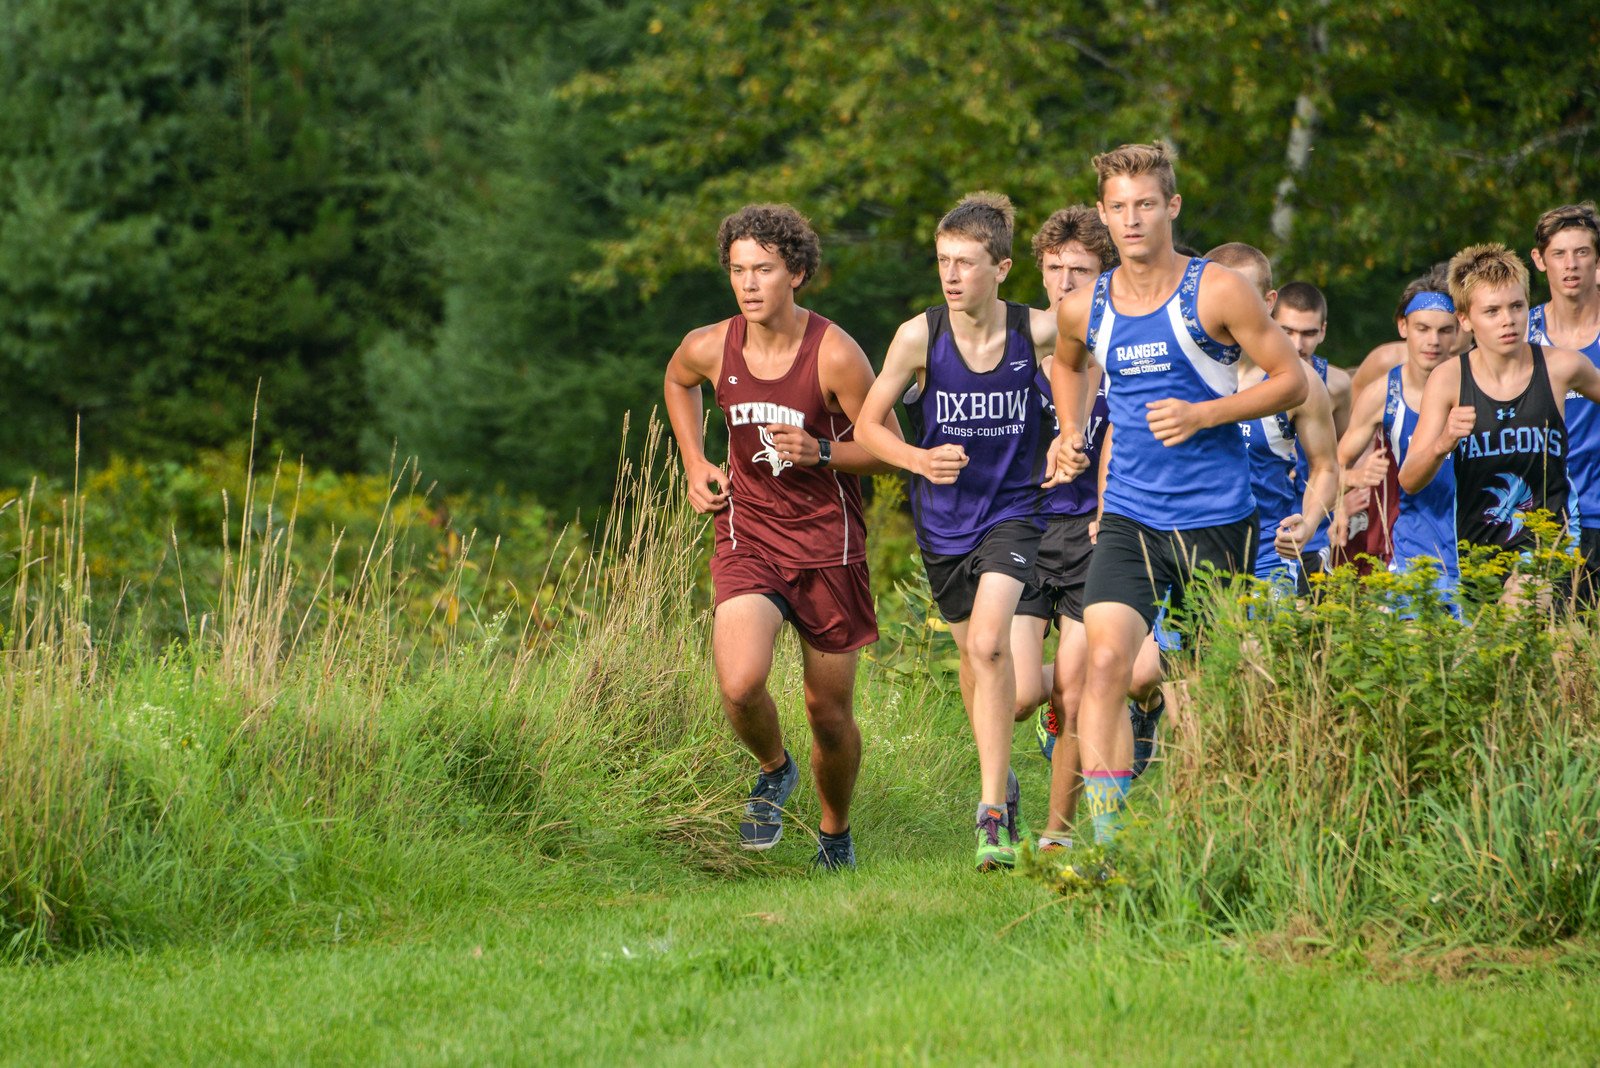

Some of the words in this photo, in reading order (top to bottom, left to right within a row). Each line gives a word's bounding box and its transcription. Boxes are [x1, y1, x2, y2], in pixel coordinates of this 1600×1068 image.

[1116, 341, 1169, 361] RANGER
[1119, 366, 1142, 376] CROSS
[1141, 362, 1171, 374] COUNTRY
[729, 401, 806, 429] LYNDON
[936, 387, 1030, 424] OXBOW
[942, 423, 1026, 437] CROSS-COUNTRY
[1458, 426, 1562, 461] FALCONS
